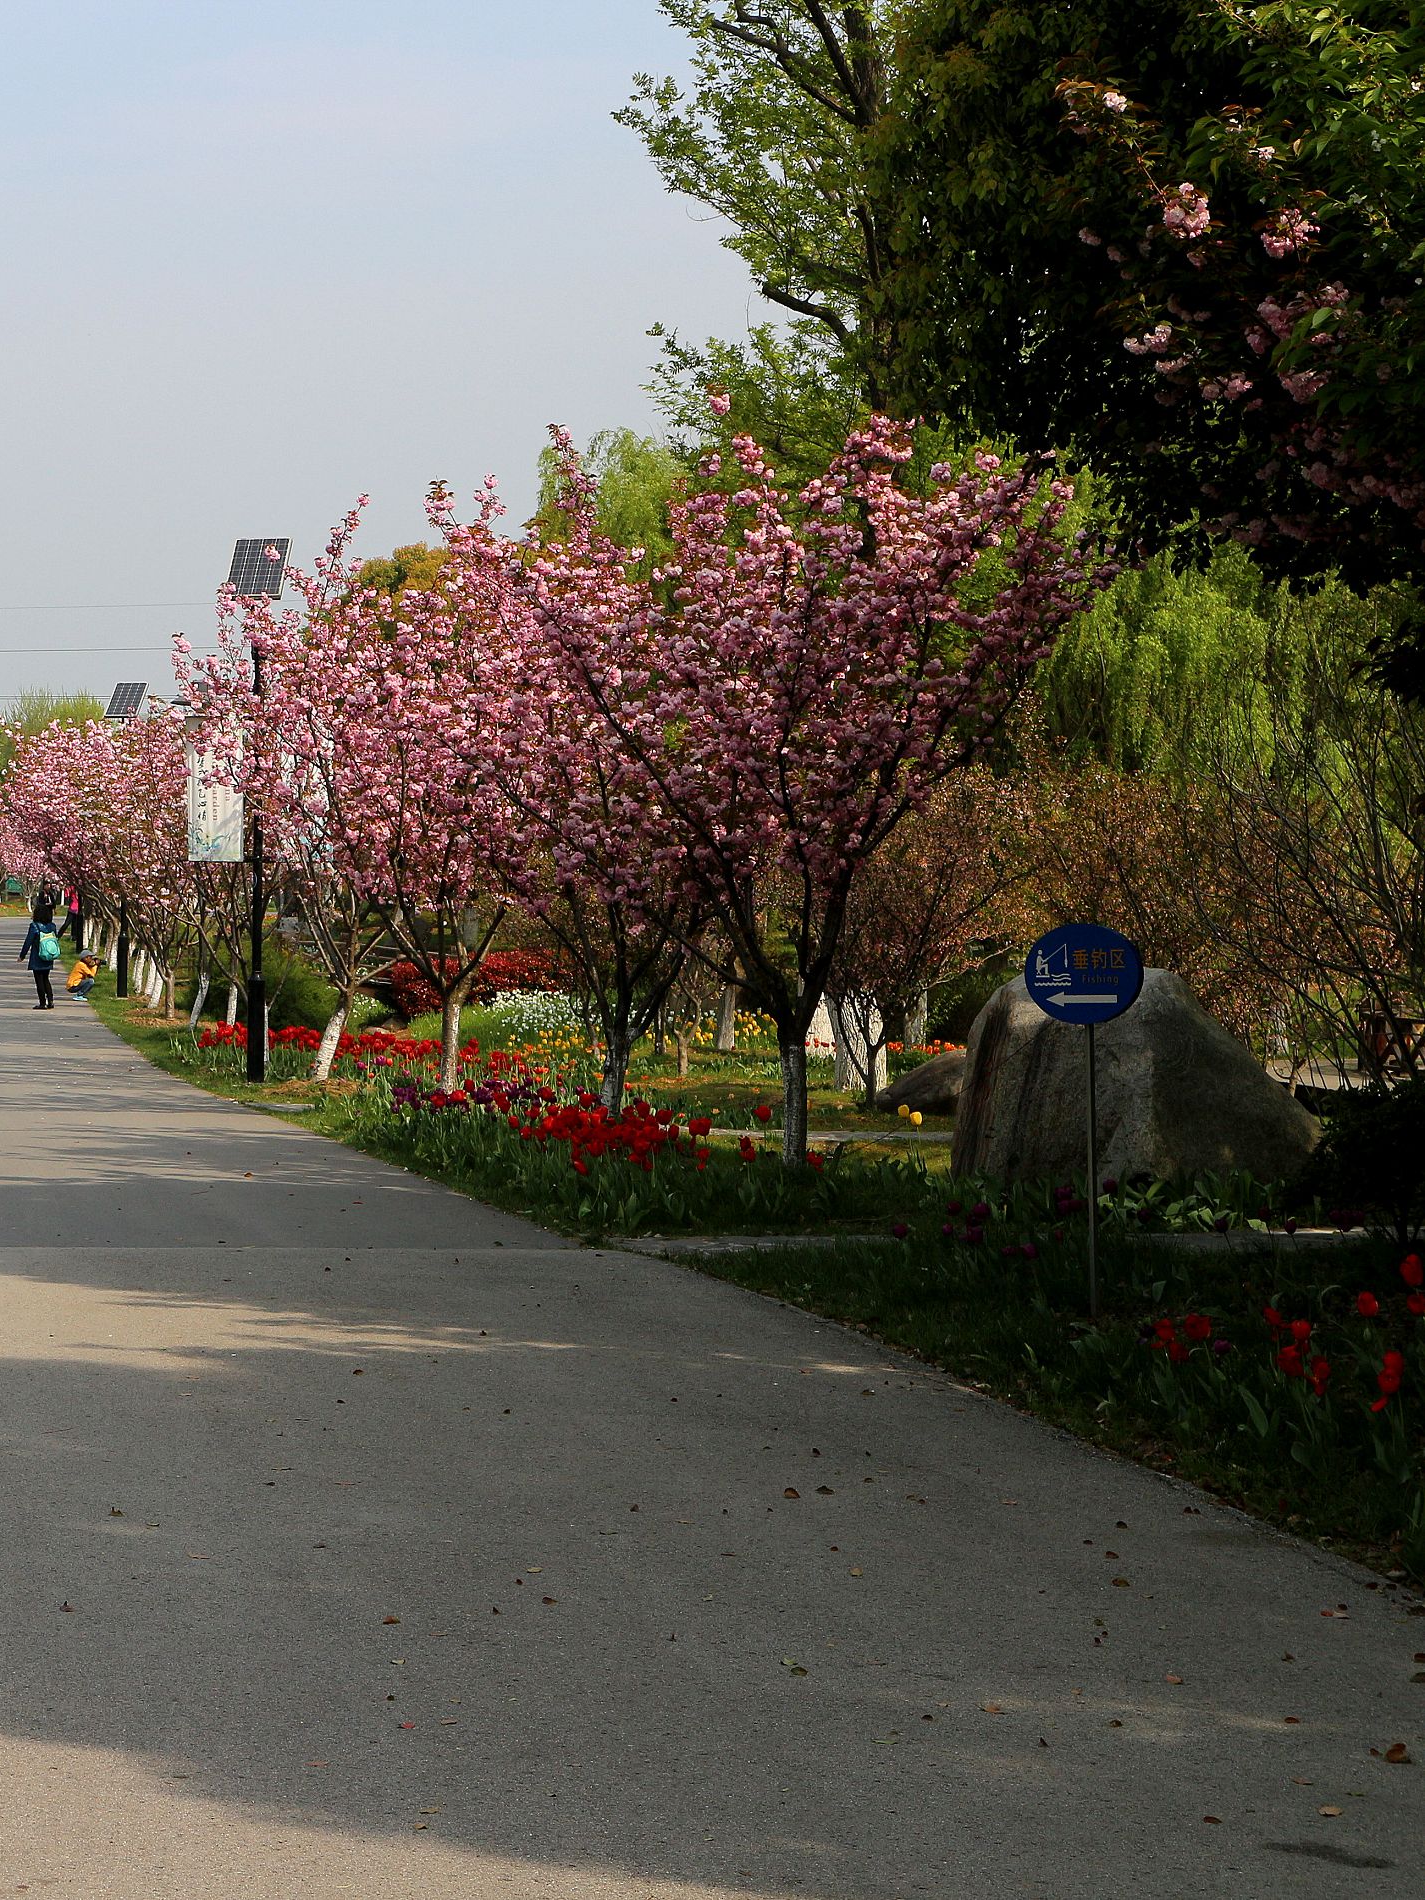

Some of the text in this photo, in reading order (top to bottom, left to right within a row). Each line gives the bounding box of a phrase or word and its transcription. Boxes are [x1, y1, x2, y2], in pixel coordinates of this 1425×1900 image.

[1072, 948, 1126, 969] 垂钓区
[1082, 974, 1119, 986] Fishing
